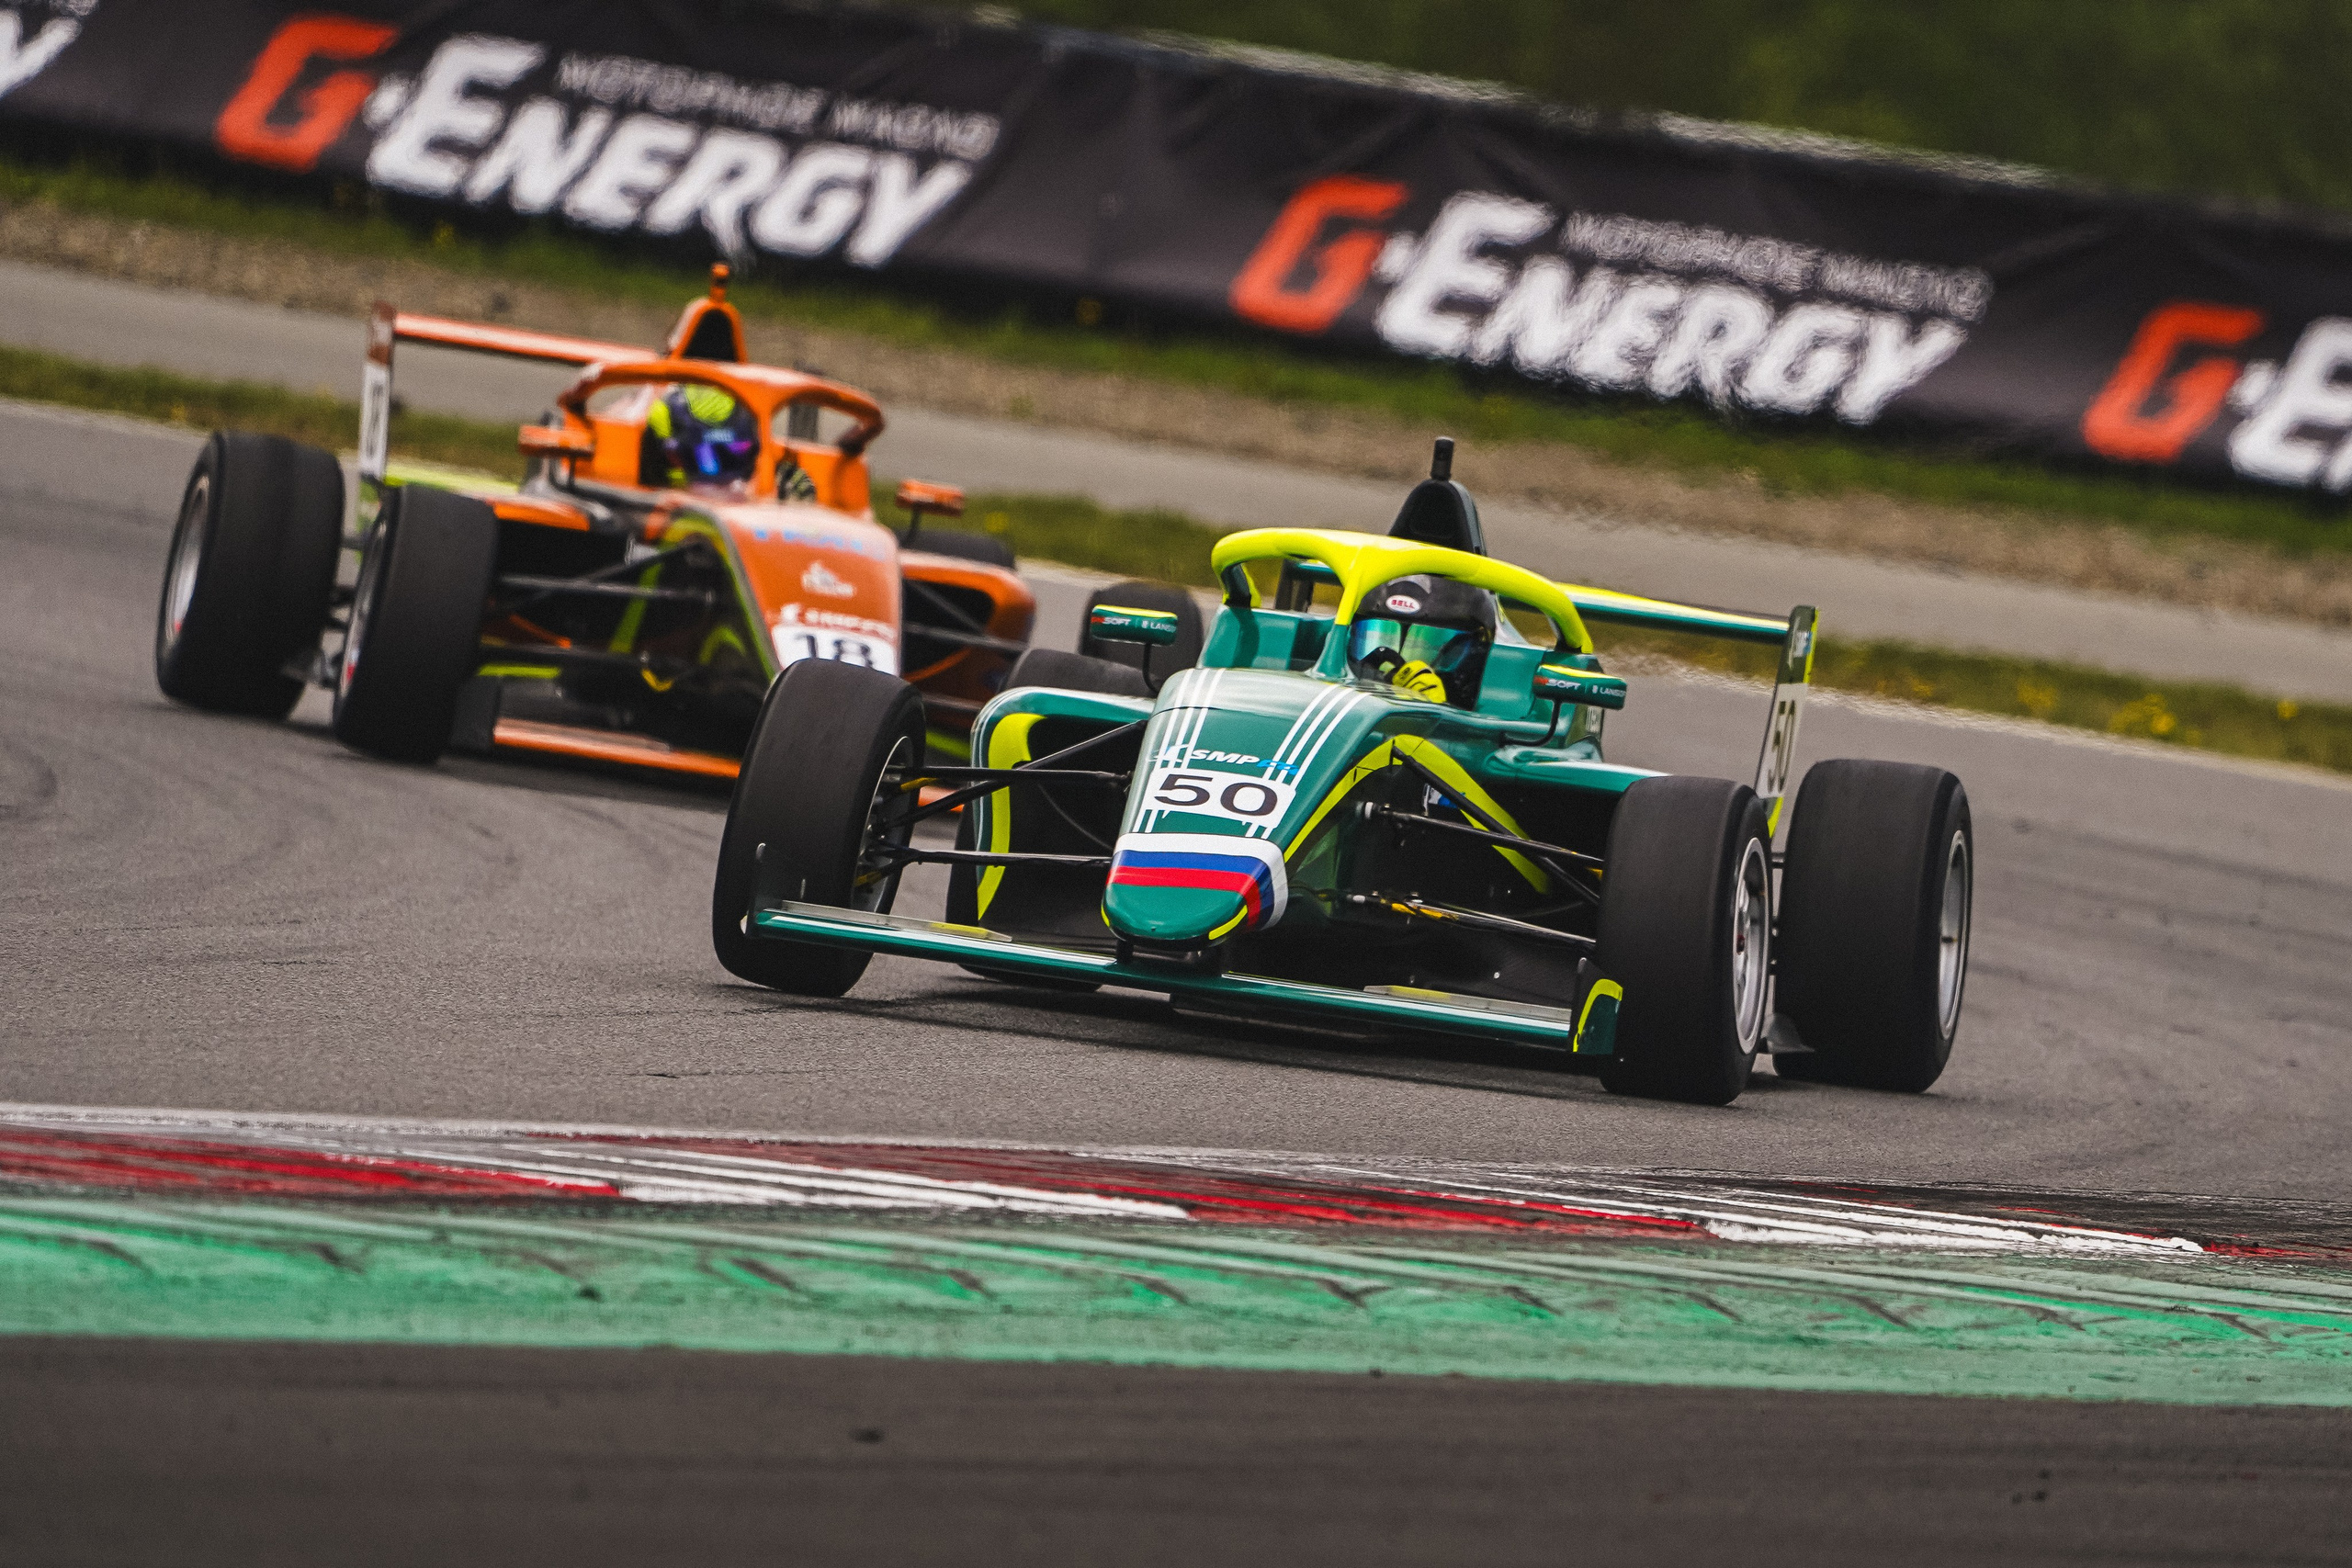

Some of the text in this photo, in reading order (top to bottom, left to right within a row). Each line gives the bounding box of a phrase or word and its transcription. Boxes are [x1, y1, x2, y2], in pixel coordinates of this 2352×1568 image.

[1391, 599, 1416, 609] BELL
[1191, 749, 1261, 764] SMP
[1768, 700, 1796, 794] 50
[1154, 773, 1278, 817] 50
